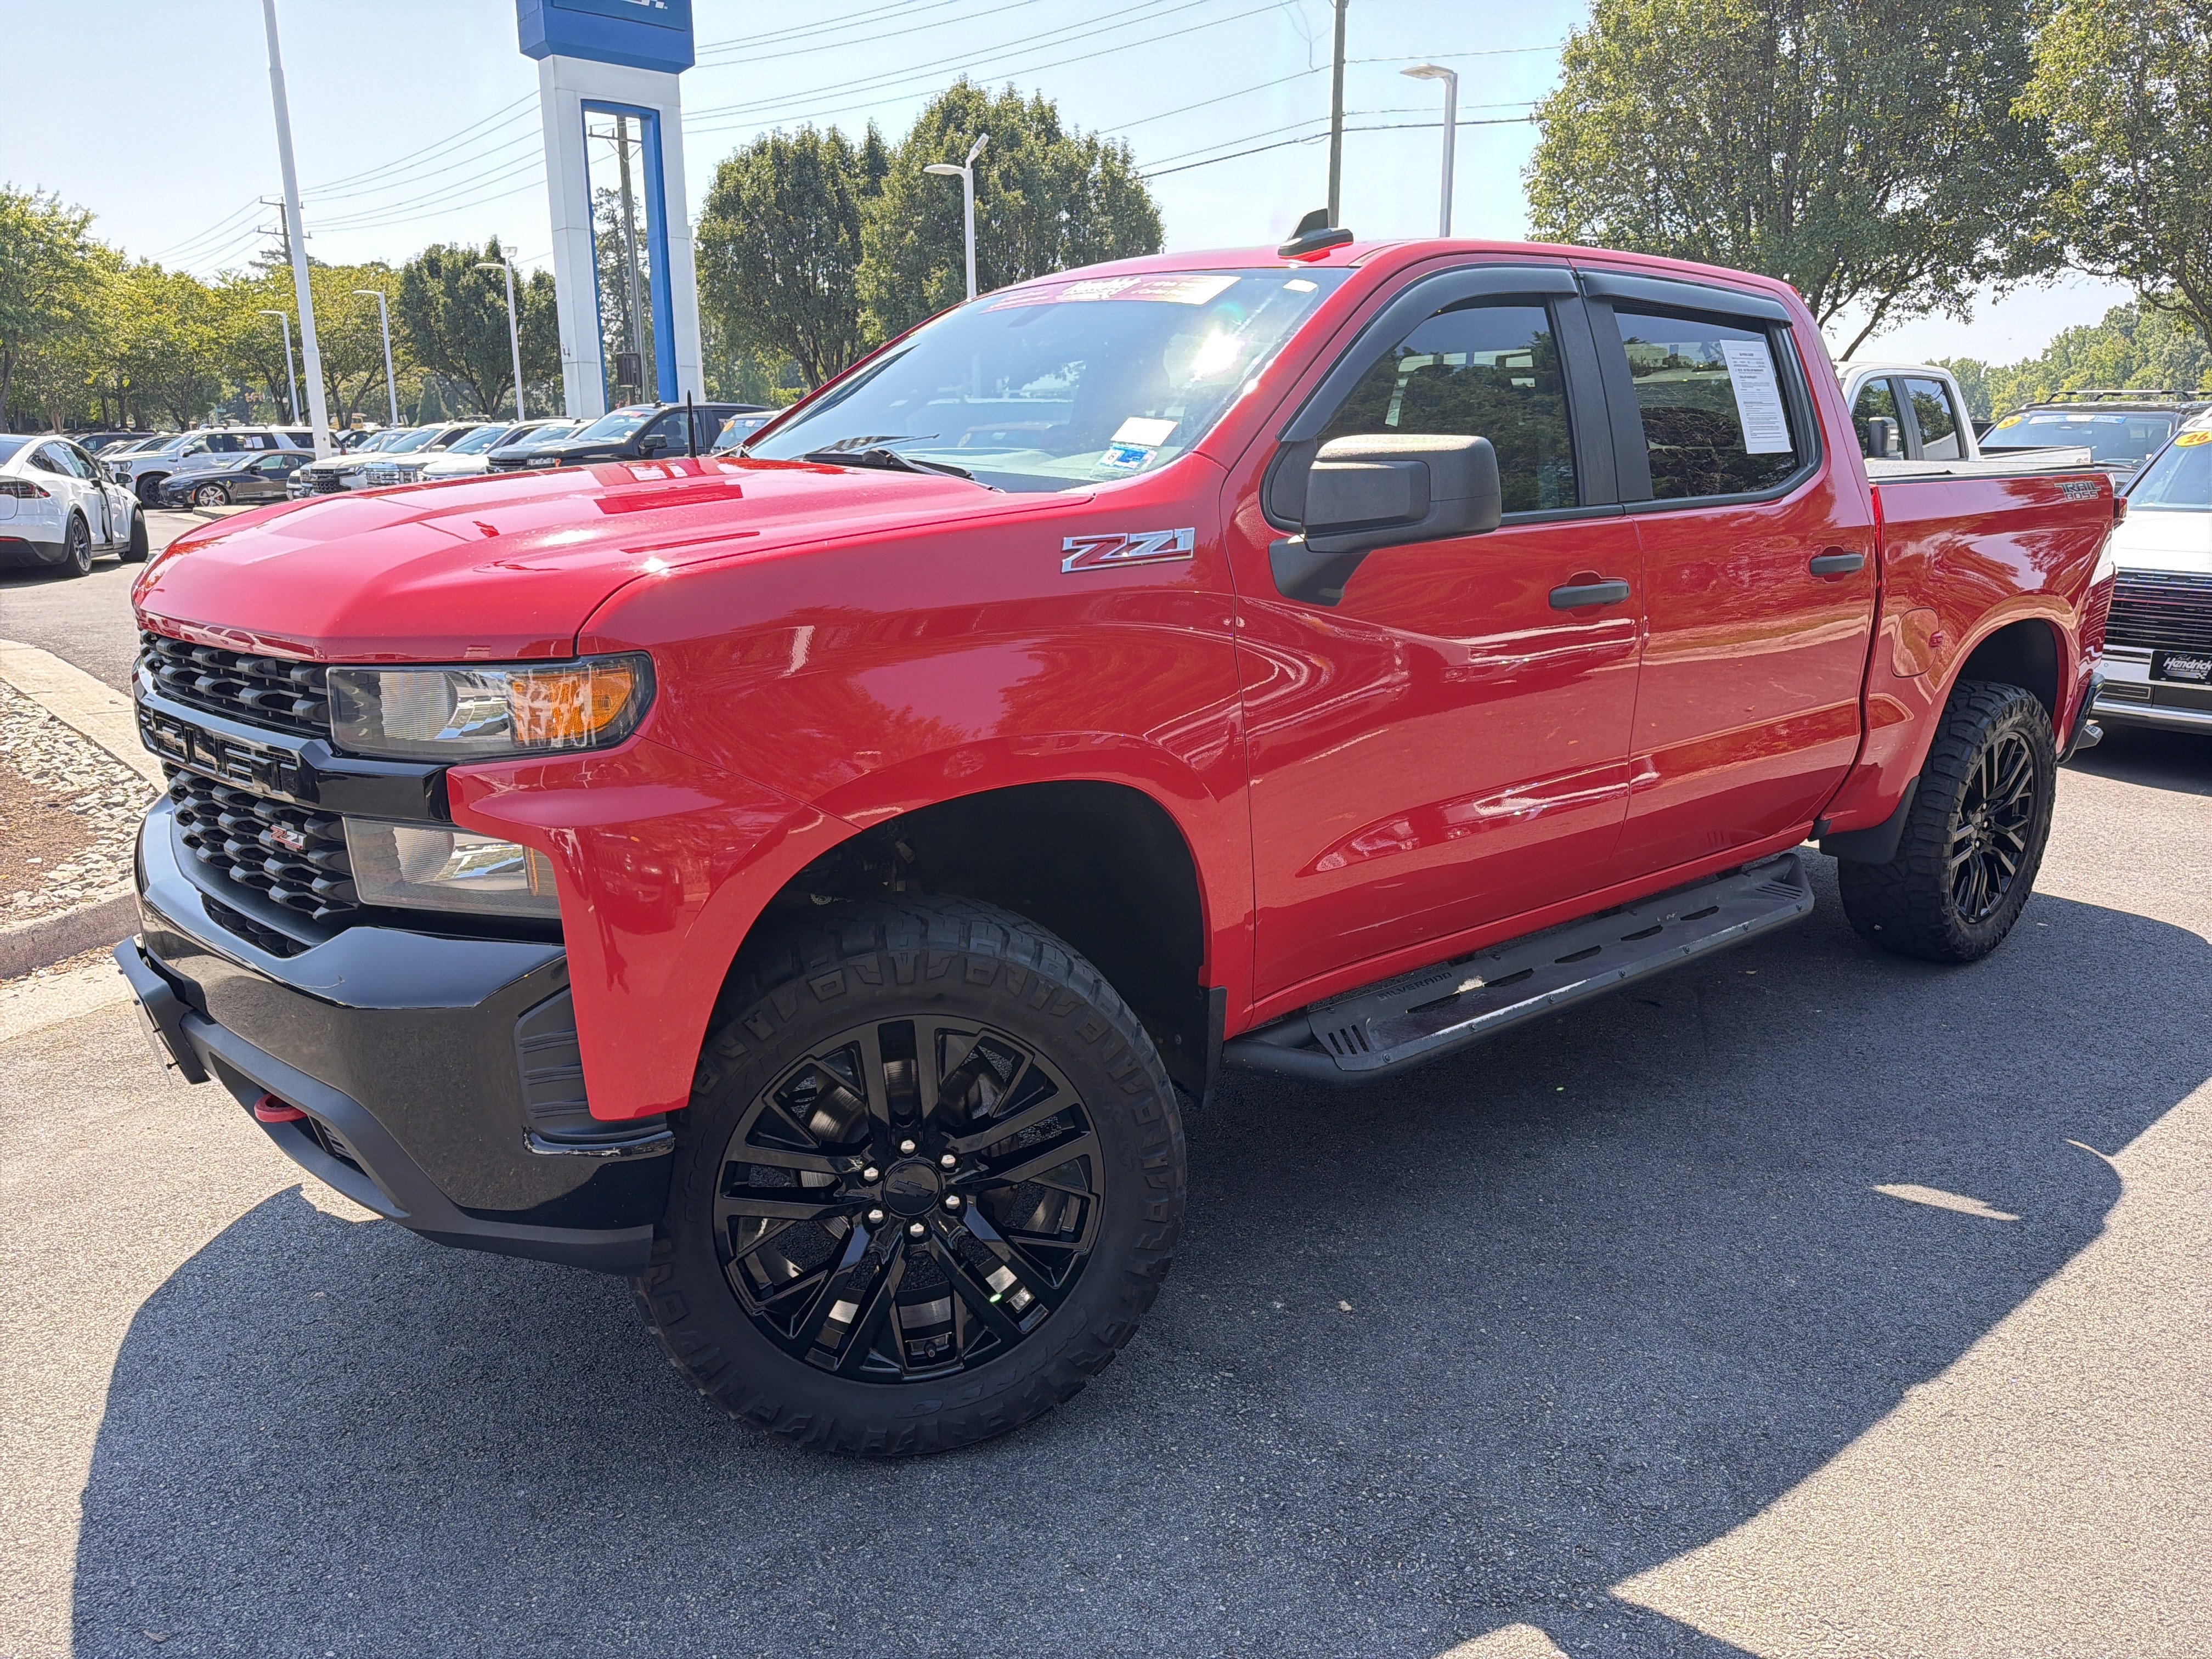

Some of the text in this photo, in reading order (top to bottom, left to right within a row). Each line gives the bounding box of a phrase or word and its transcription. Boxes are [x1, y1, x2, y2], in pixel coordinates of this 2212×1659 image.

[2185, 432, 2208, 443] 26
[2055, 480, 2101, 493] TRAIL
[2065, 491, 2099, 500] BOSS
[1061, 527, 1195, 573] Z71
[2163, 657, 2212, 670] Hendrick
[270, 825, 303, 850] Z71
[1377, 972, 1452, 1000] SILVERADO
